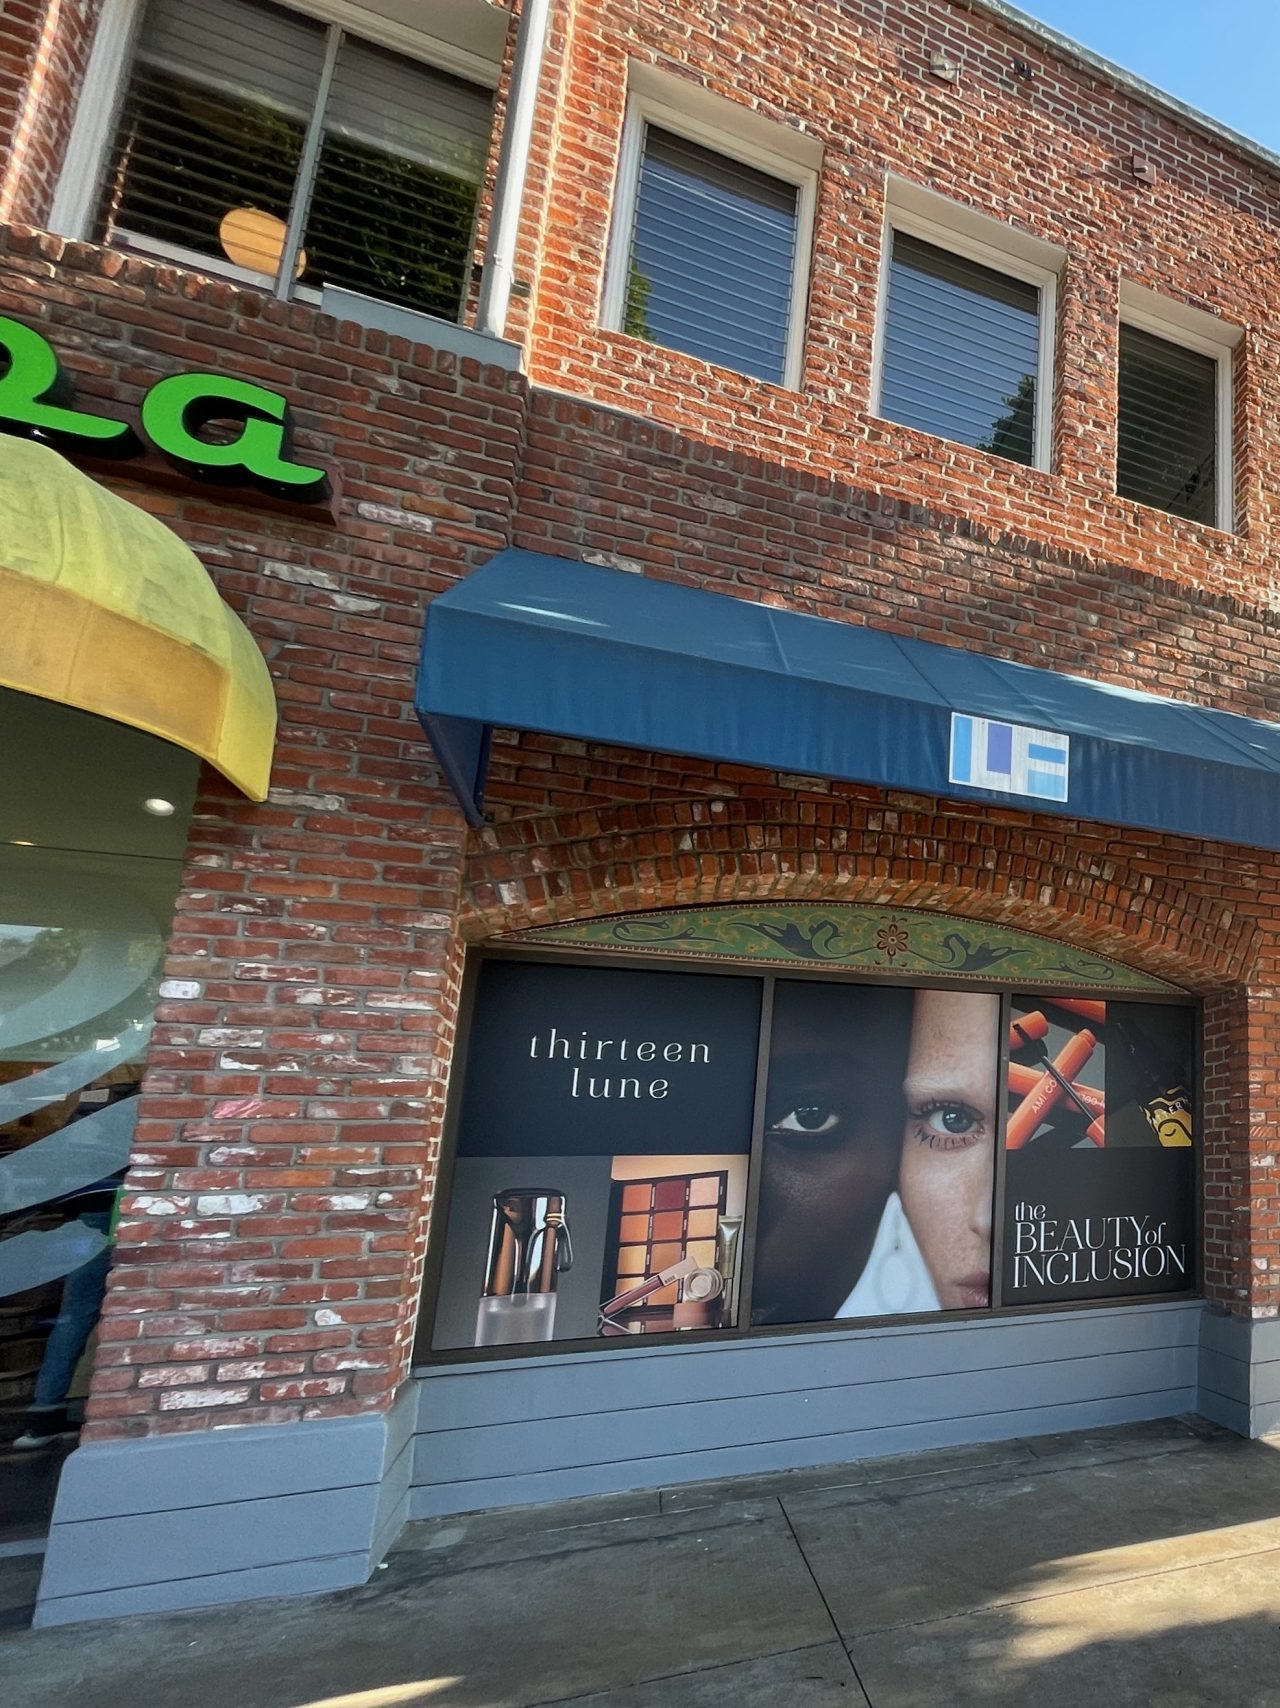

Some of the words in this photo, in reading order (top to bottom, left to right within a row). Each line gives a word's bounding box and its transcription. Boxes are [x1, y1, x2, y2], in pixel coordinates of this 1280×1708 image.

[529, 1028, 711, 1064] thirteen
[571, 1067, 669, 1099] lune
[1031, 1094, 1047, 1114] AMI
[1014, 1201, 1047, 1221] the
[1014, 1215, 1151, 1255] BEAUTY
[1144, 1221, 1167, 1246] of
[1012, 1243, 1187, 1289] INCLUSION
